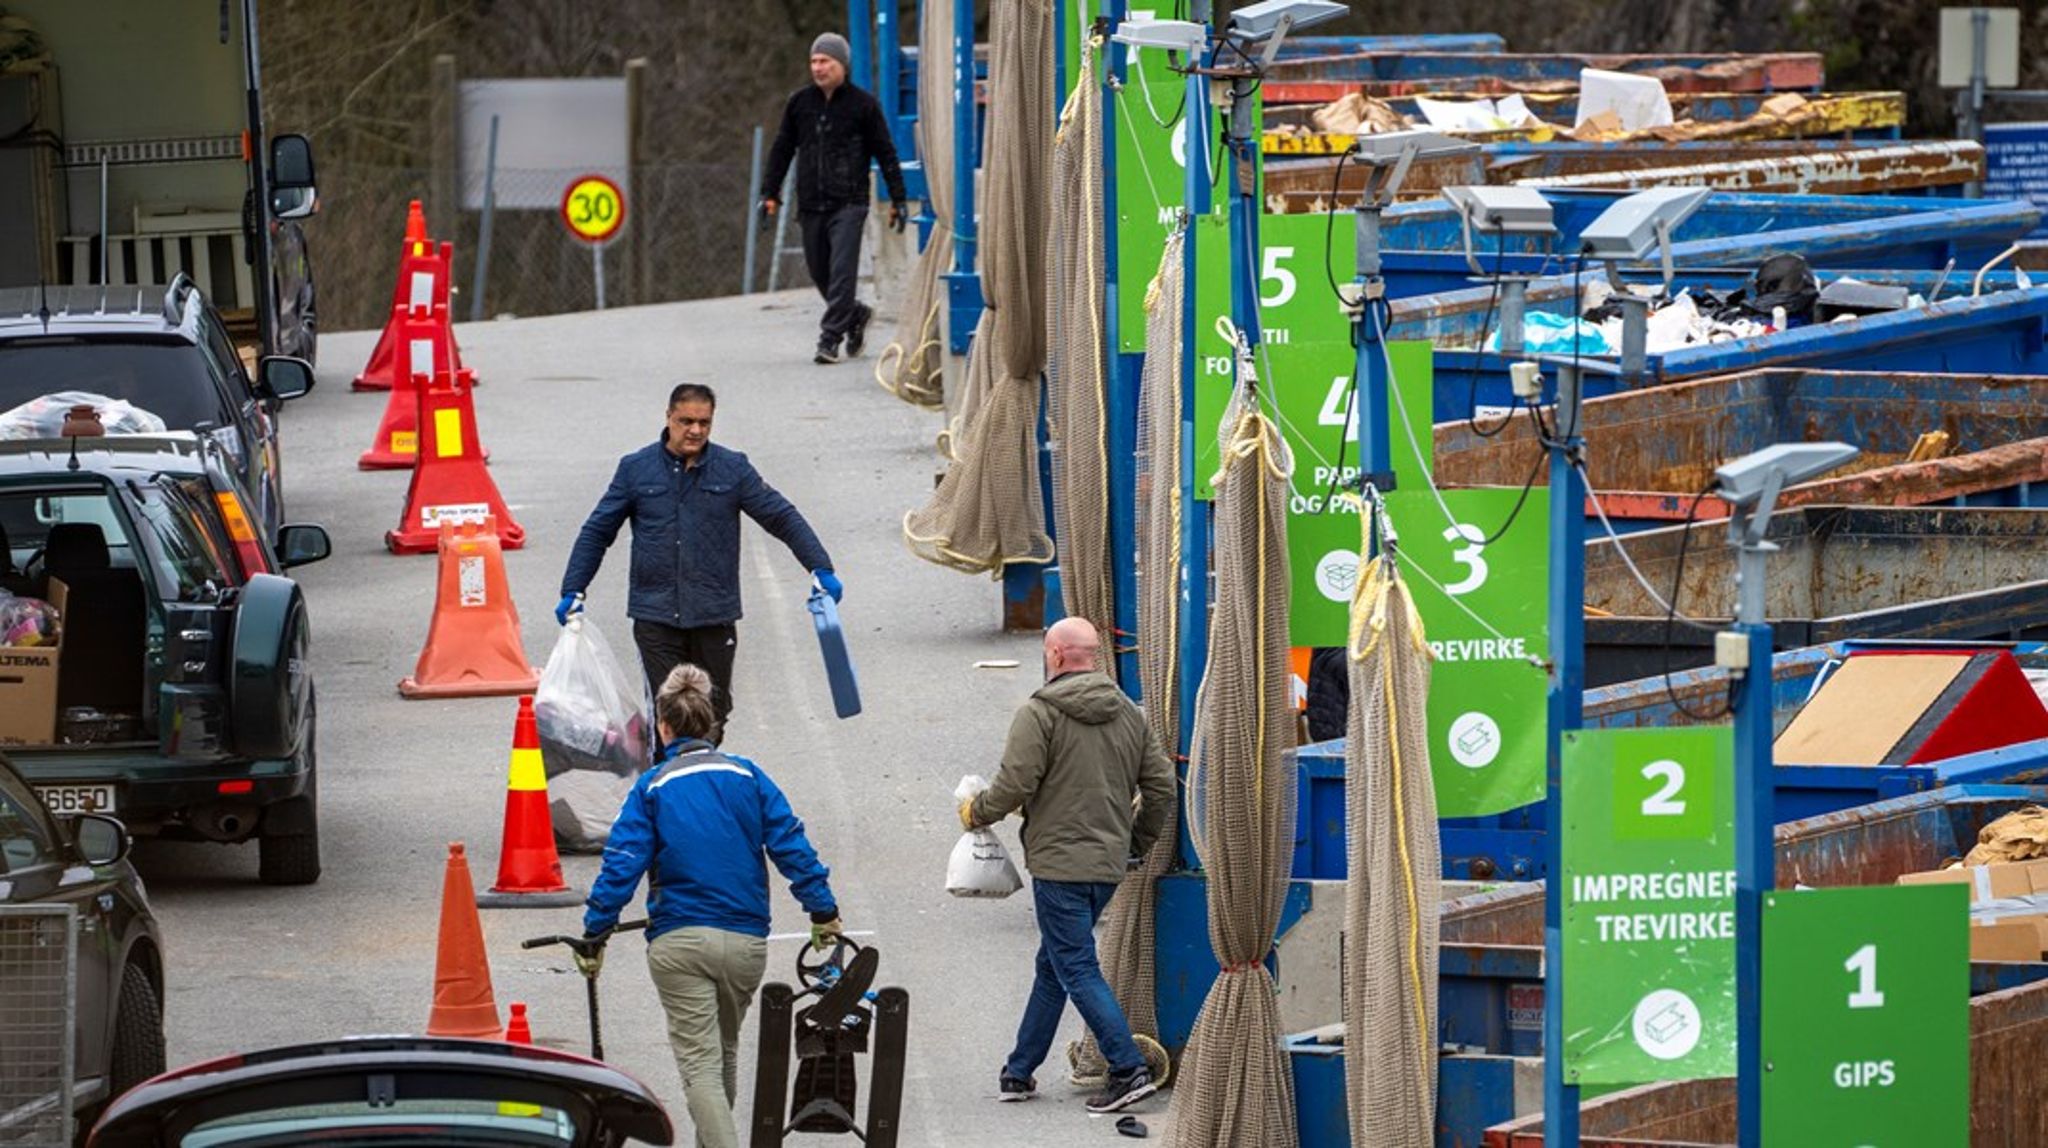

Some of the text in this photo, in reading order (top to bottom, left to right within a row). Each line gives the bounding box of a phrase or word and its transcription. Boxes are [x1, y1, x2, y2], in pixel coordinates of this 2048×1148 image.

[575, 192, 613, 223] 30
[1260, 246, 1297, 307] 5
[1318, 376, 1359, 442] 4
[1442, 523, 1488, 596] 3
[1428, 638, 1526, 662] REVIRKE
[1640, 759, 1687, 816] 2
[1573, 872, 1737, 903] IMPREGNER
[1595, 911, 1735, 942] TREVIRKE
[1844, 943, 1885, 1009] 1
[1833, 1059, 1896, 1088] GIPS
